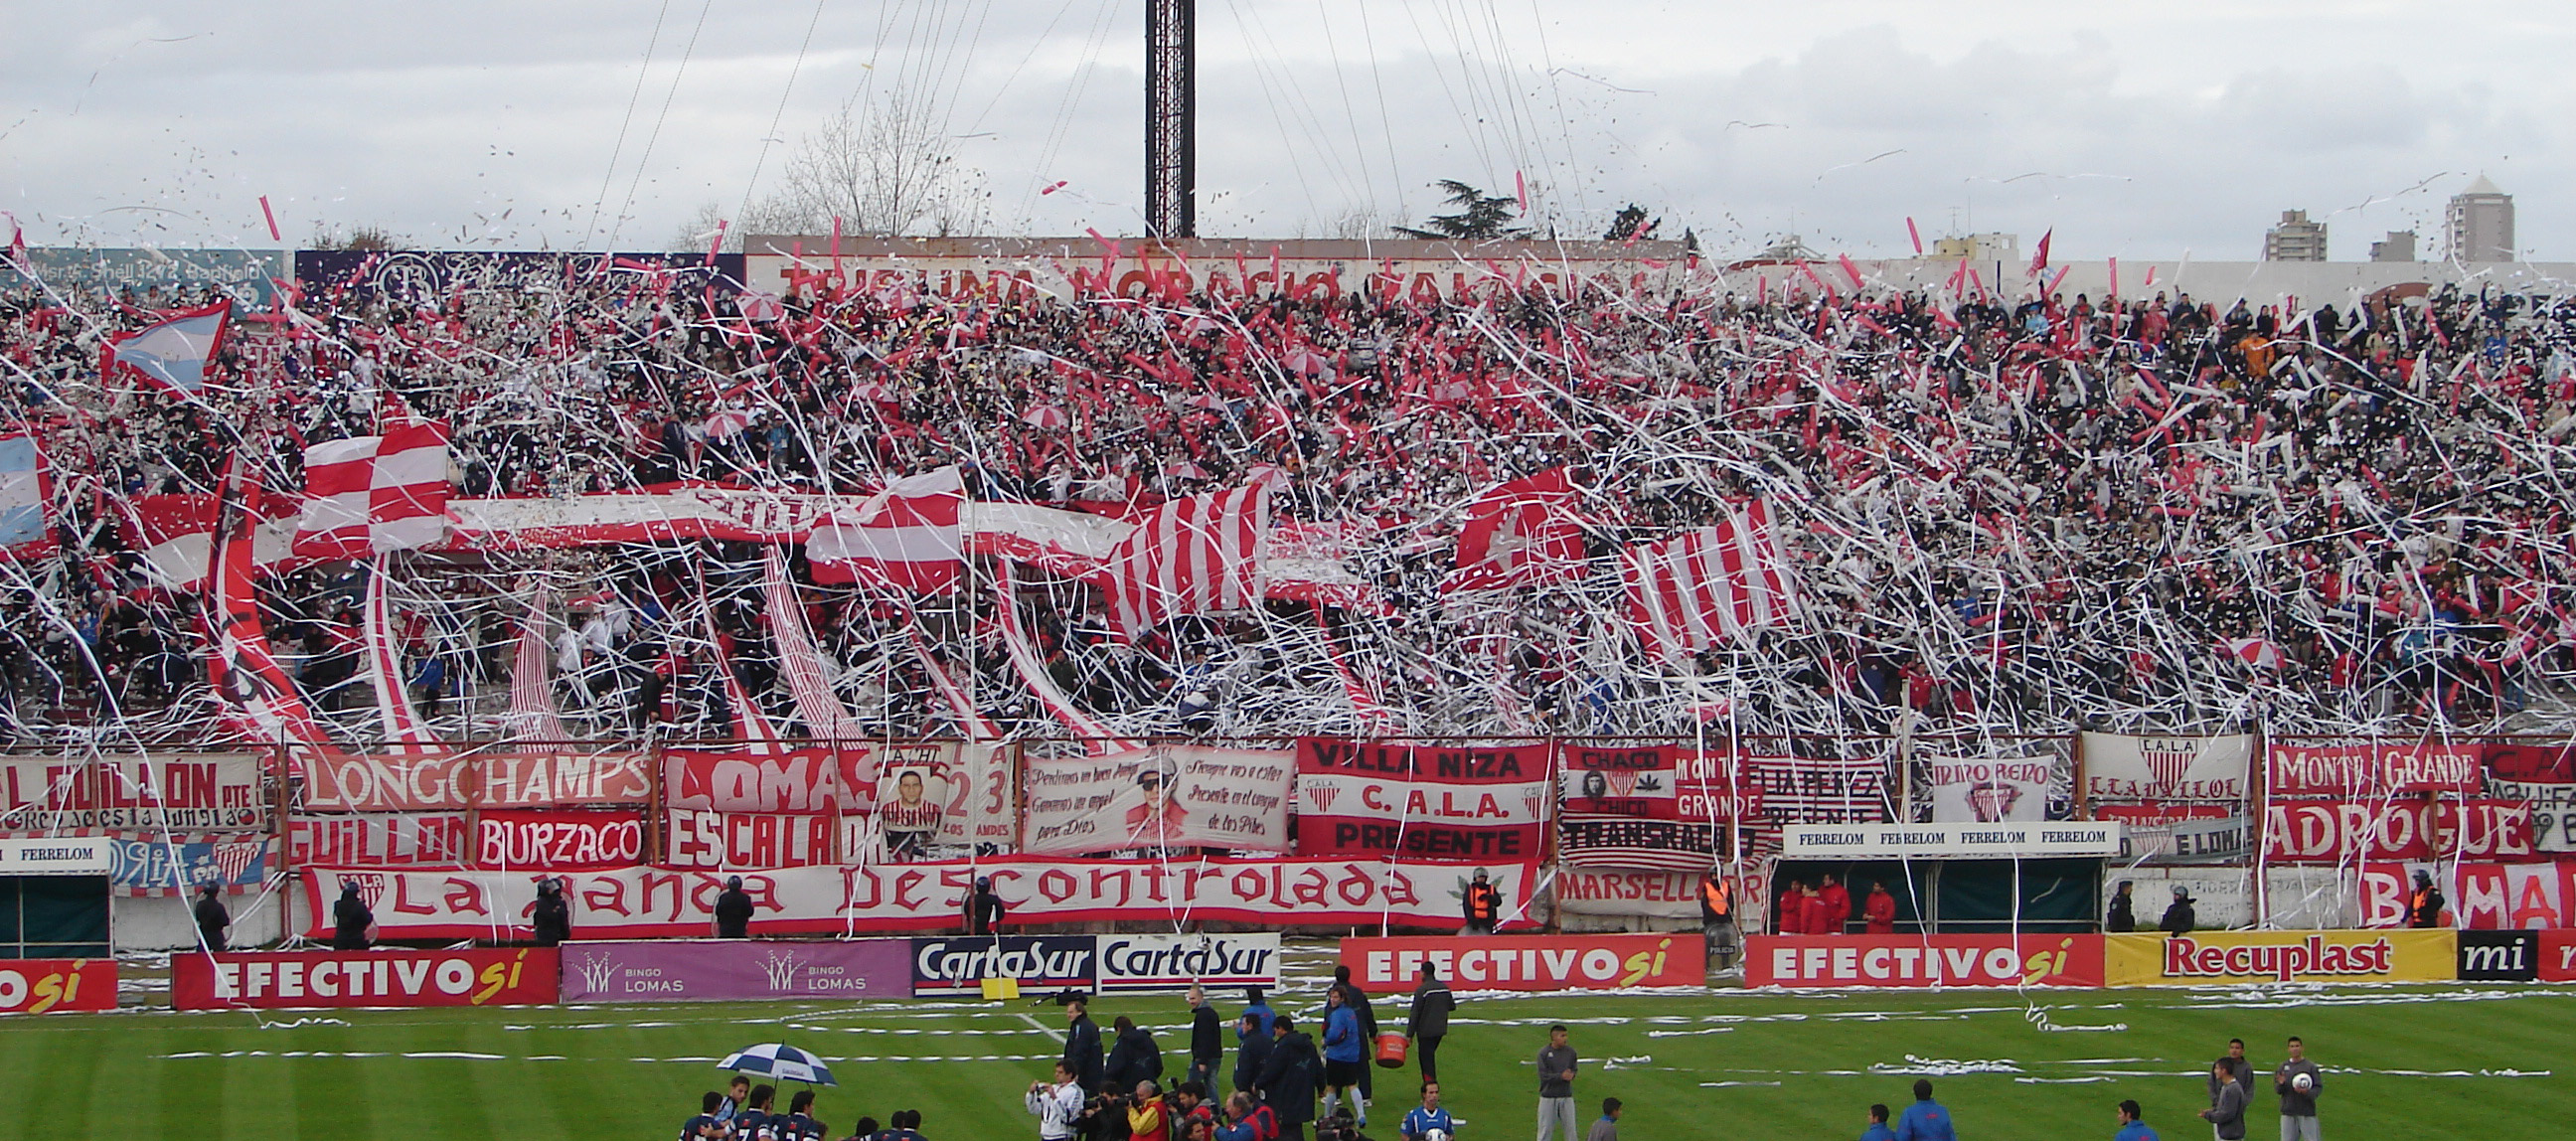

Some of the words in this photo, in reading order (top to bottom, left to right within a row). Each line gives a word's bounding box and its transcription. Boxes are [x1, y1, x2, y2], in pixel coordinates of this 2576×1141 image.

[1581, 750, 1659, 769] CHACO
[2385, 750, 2476, 789] GRANDE
[304, 757, 652, 805] LONGCHAMPS
[664, 754, 881, 812] LOMAS
[481, 817, 643, 868] BURZACO
[943, 823, 963, 836] LOS
[976, 823, 1010, 836] ANDES
[1335, 822, 1521, 856] PRESENTE
[1799, 833, 1864, 846] FERRELOM
[1880, 832, 1945, 845] FERRELOM
[1961, 831, 2025, 844] FERRELOM
[2041, 831, 2106, 844] FERRELOM
[2266, 803, 2530, 857] ADROGUE
[21, 848, 94, 862] FERRELOM
[393, 874, 491, 916] La
[808, 966, 845, 975] BINGO
[917, 940, 1091, 981] CartaSur
[1101, 940, 1272, 977] CartaSur
[2164, 934, 2392, 982] Recuplast
[2464, 938, 2525, 971] mi
[625, 968, 662, 977] BINGO
[625, 978, 685, 993] LOMAS
[808, 977, 868, 991] LOMAS
